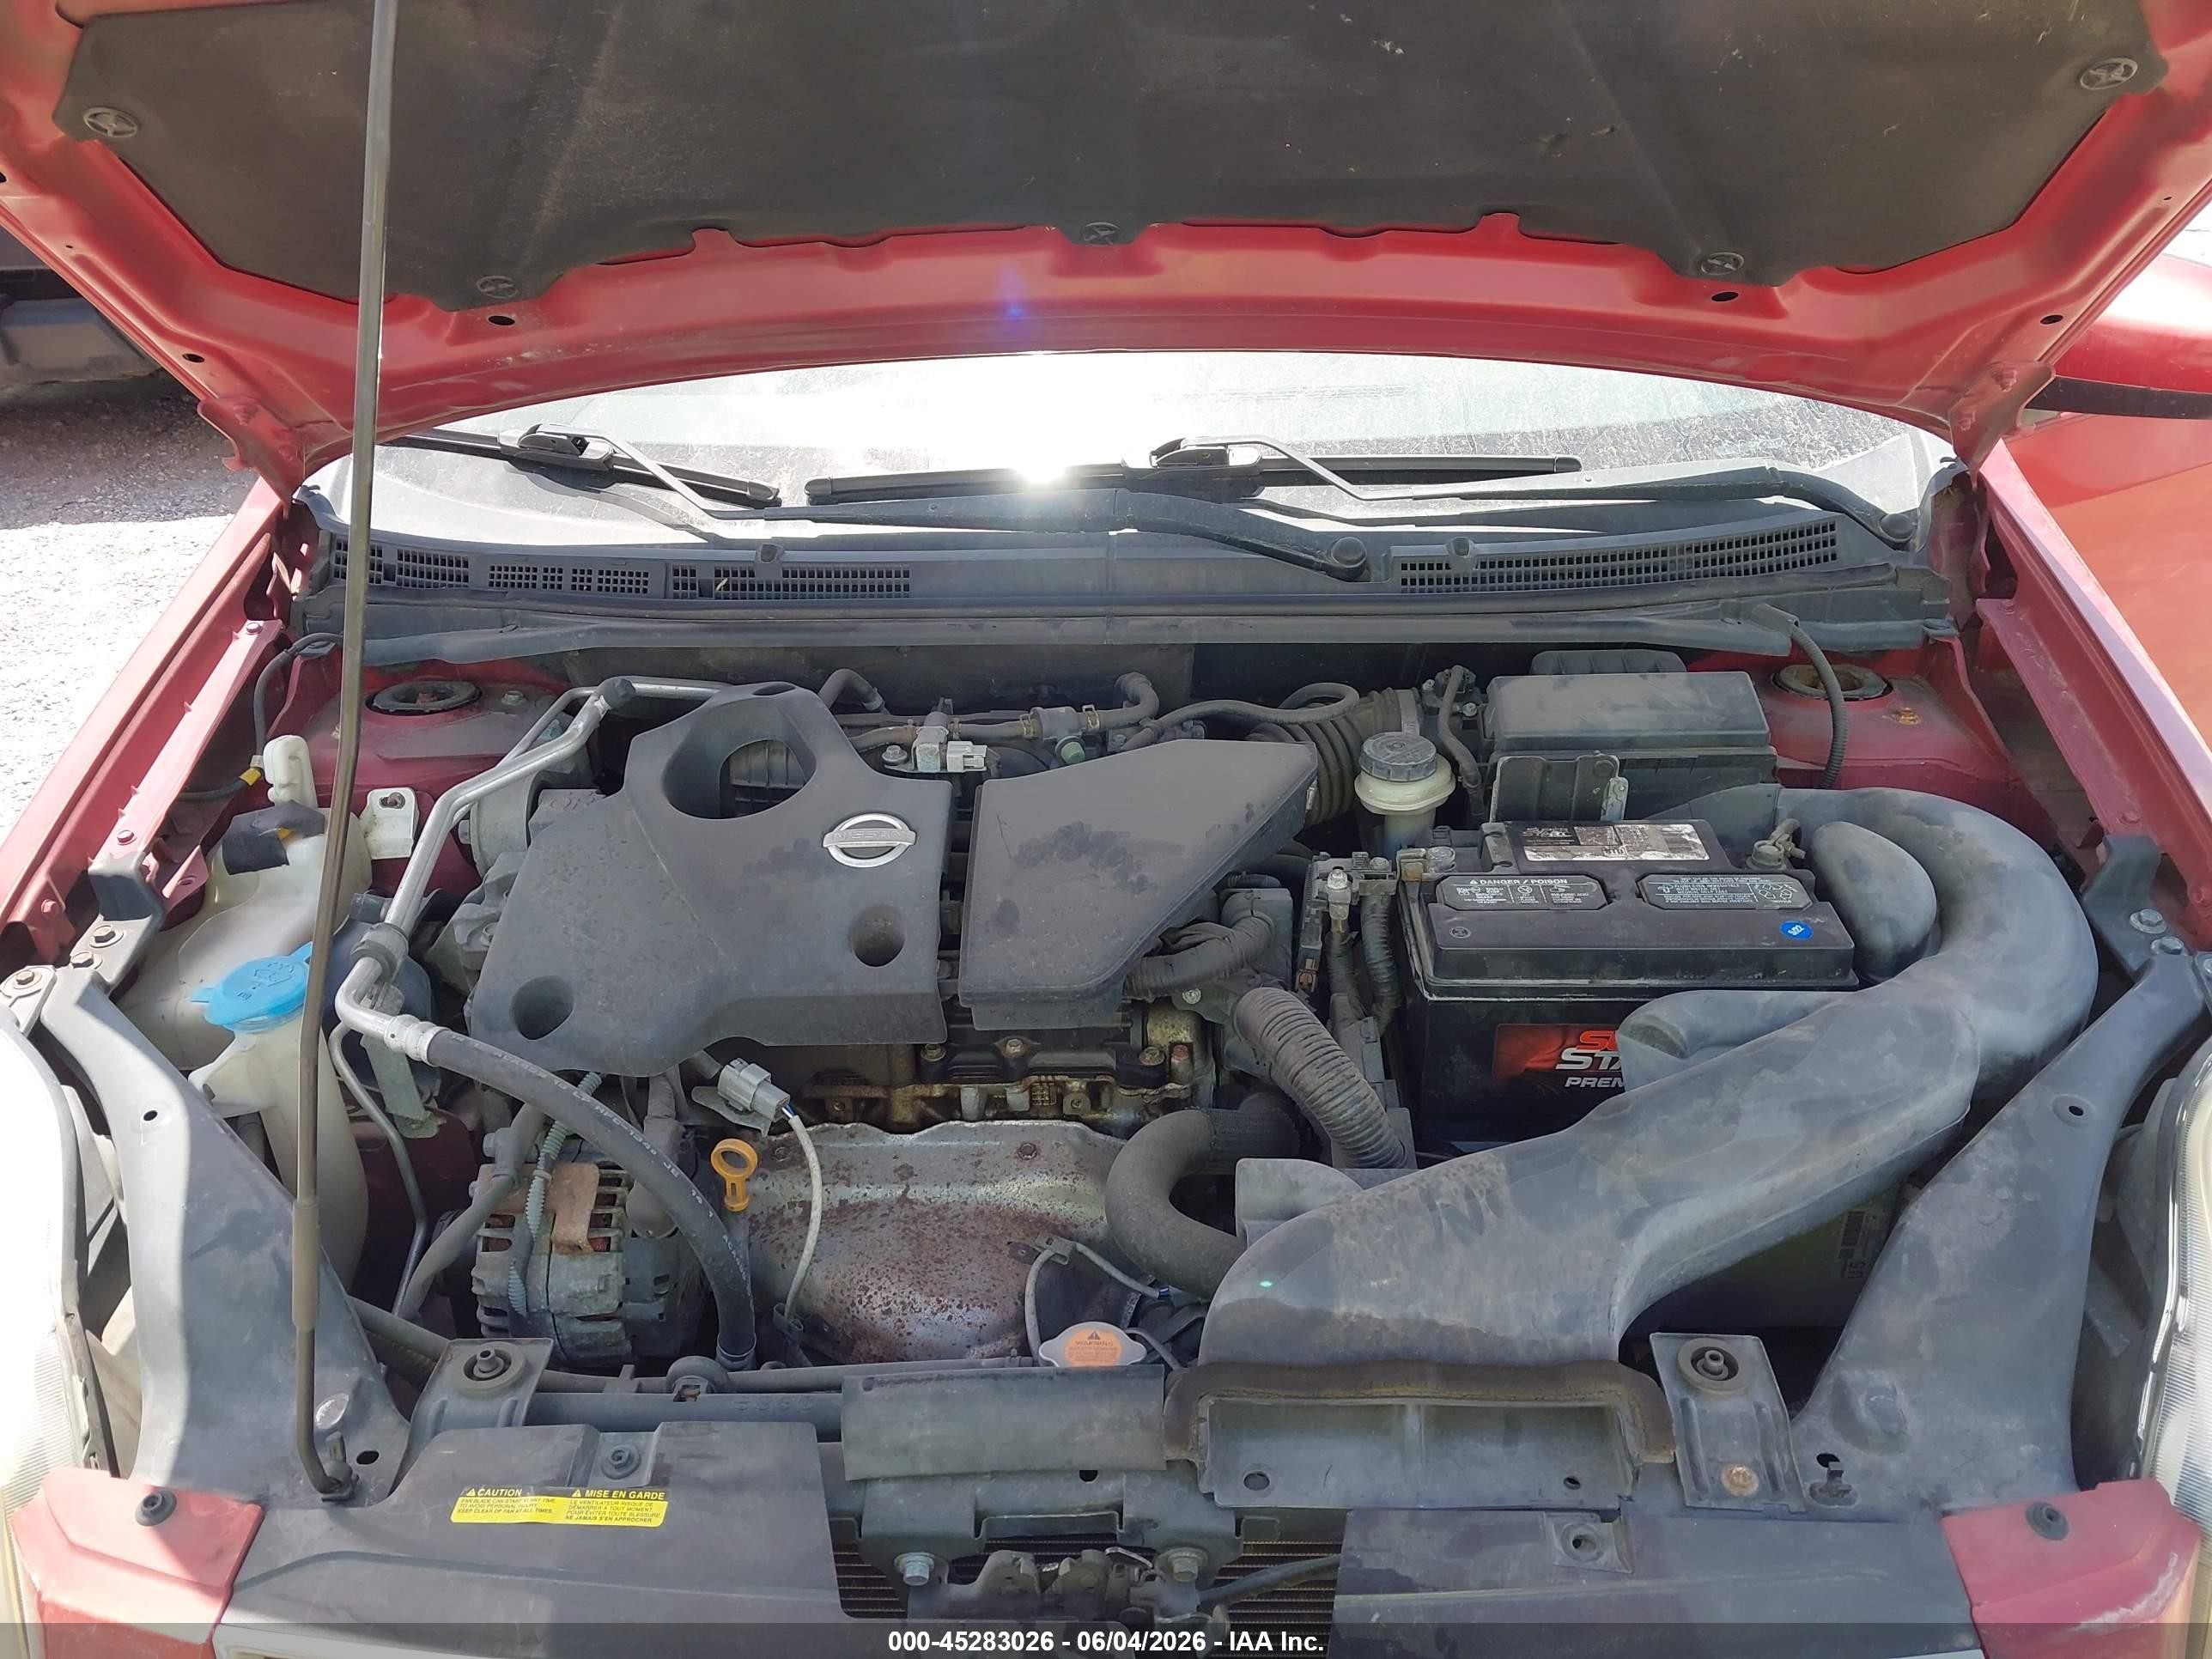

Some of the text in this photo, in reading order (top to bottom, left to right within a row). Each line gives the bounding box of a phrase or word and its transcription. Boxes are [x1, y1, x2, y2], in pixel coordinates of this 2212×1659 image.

[831, 830, 900, 840] NISSAN
[477, 1488, 523, 1497] CAUTION
[584, 1489, 665, 1500] MISE EN GARDE
